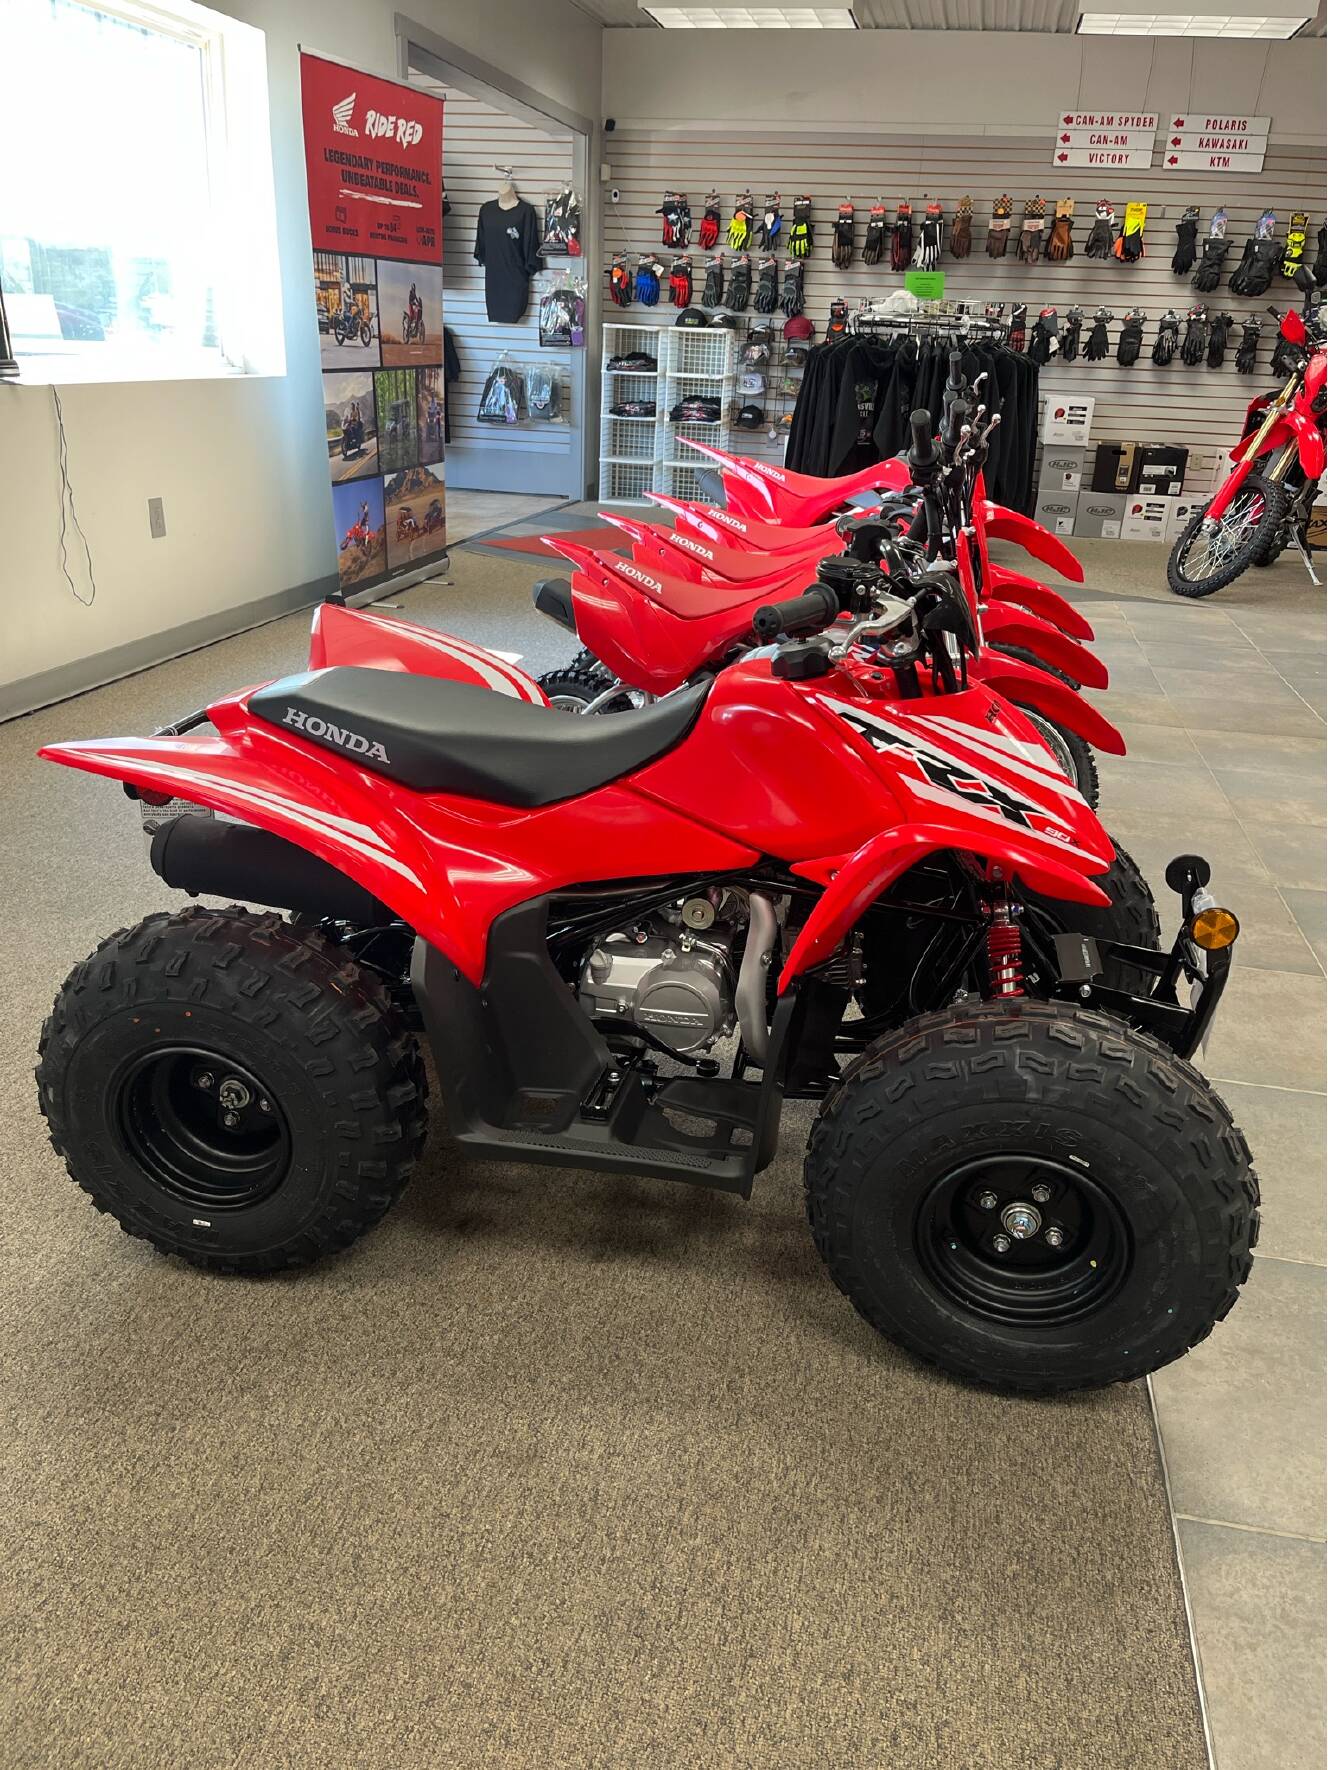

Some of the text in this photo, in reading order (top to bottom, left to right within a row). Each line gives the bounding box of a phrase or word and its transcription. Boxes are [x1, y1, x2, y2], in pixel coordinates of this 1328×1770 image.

[333, 124, 359, 137] HONDA
[365, 109, 423, 150] RIDE RED
[1075, 115, 1154, 128] CAN-AM SPYDER
[1205, 119, 1248, 131] POLARIS
[1089, 134, 1128, 146] CAN-AM
[1198, 137, 1248, 150] KAWASAKI
[324, 148, 432, 185] LEGENDARY PERFORMANCE.
[1088, 153, 1130, 165] VICTORY
[1209, 157, 1231, 168] KTM
[342, 169, 419, 198] UNBEATABLE DEALS.
[754, 462, 786, 482] HONDA
[708, 508, 747, 533] HONDA
[669, 533, 714, 561] HONDA
[615, 561, 663, 595] HONDA
[282, 706, 390, 764] HONDA
[644, 1012, 703, 1026] HONDA
[896, 1119, 1084, 1179] MAXXIS
